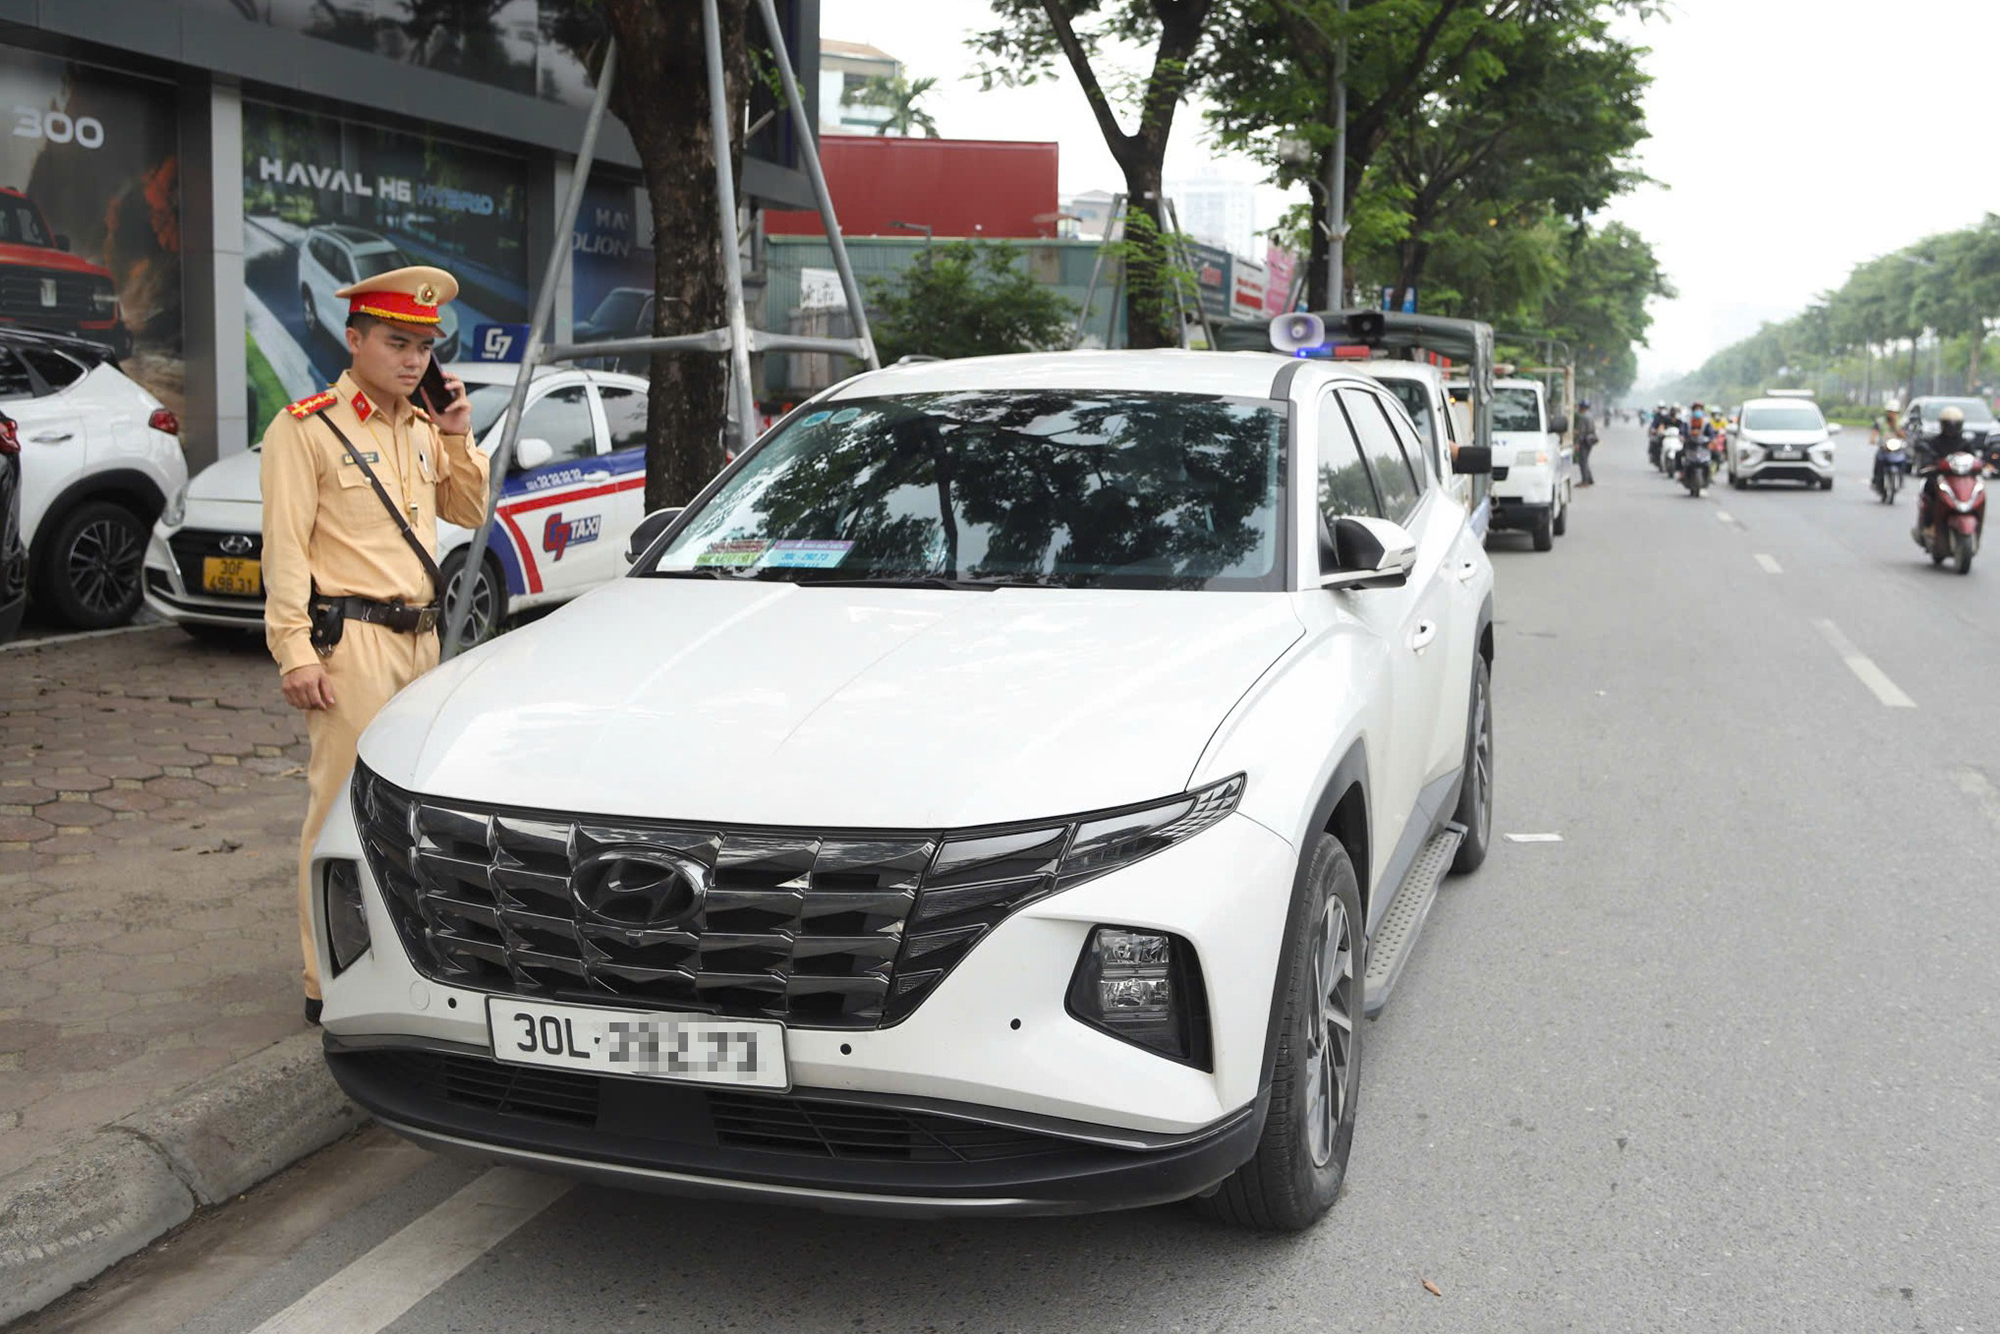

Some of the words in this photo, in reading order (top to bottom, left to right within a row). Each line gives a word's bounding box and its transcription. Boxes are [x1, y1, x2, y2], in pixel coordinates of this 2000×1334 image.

[12, 105, 104, 149] 300
[260, 156, 373, 196] HAVAL
[379, 177, 411, 202] H6
[596, 208, 629, 230] HA
[573, 231, 629, 257] OLION
[485, 328, 512, 360] G7
[543, 512, 570, 563] G7
[570, 516, 601, 540] TAXI
[514, 1012, 591, 1059] 30L
